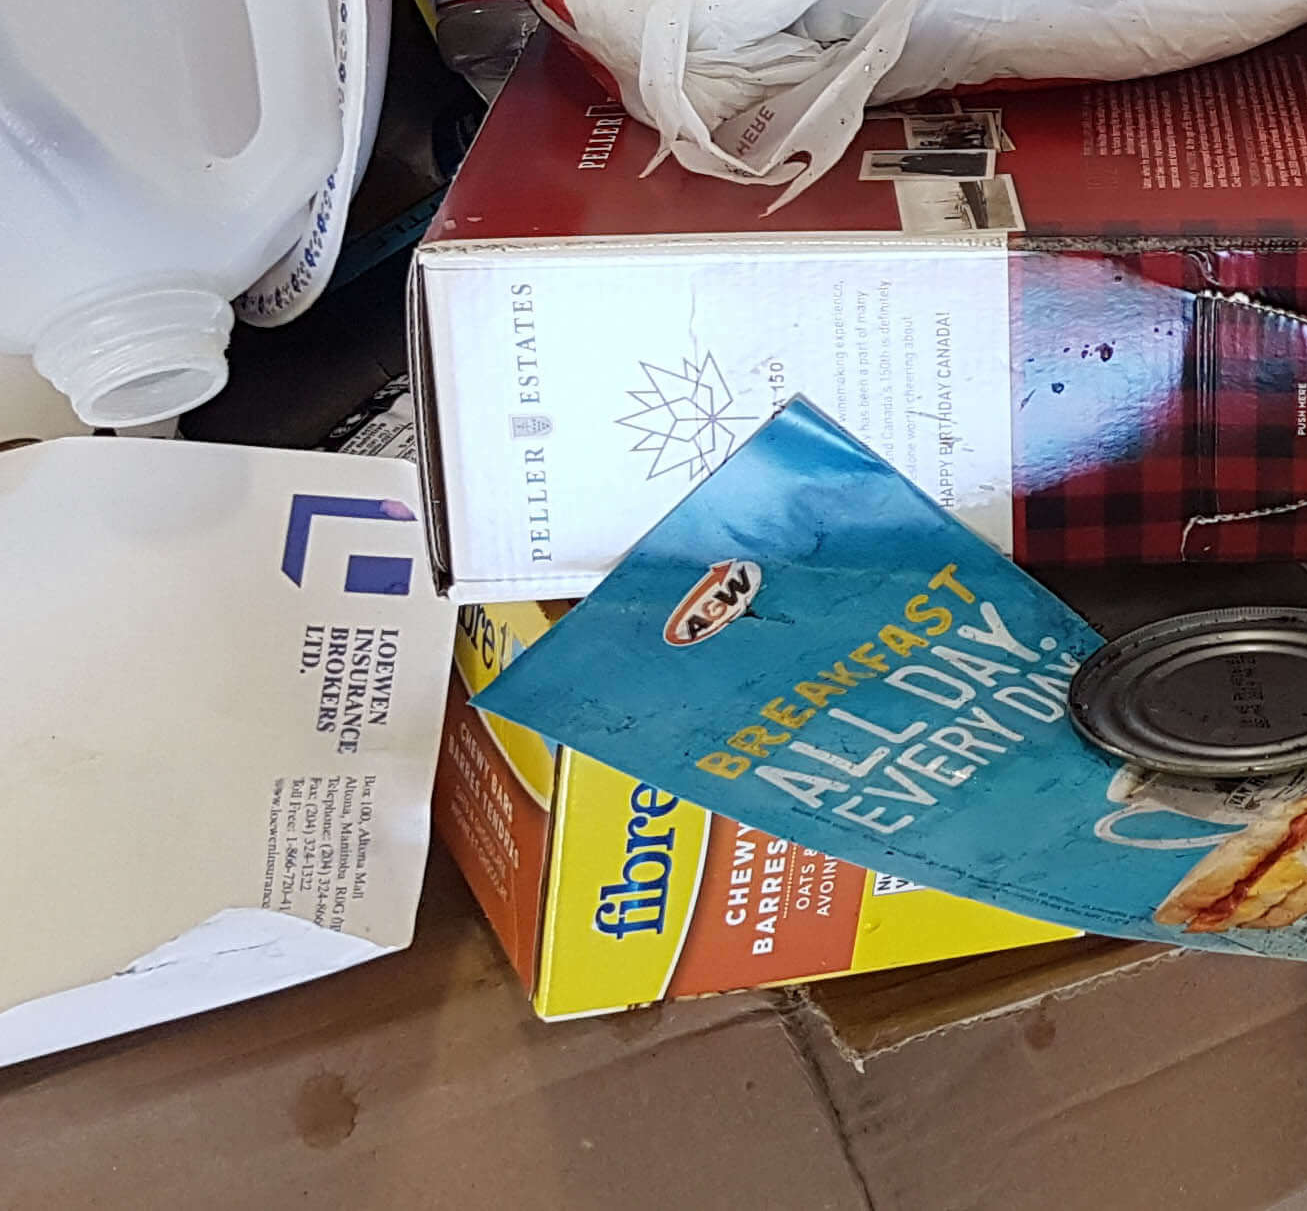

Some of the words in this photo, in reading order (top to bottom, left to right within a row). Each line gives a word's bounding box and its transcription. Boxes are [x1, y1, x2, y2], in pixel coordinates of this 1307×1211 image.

[577, 116, 625, 169] PELLER
[735, 104, 775, 157] HERE
[510, 283, 541, 405] ESTATES
[879, 279, 893, 341] definitely
[935, 311, 952, 379] CANADA!
[768, 361, 785, 393] 150
[937, 386, 954, 456] BIRTHDAY
[1296, 410, 1307, 436] PUSH
[523, 446, 553, 562] PELLER
[939, 461, 955, 508] HAPPY
[299, 625, 326, 675] LTD.
[316, 626, 350, 733] BROKERS
[368, 628, 399, 726] LOEWEN
[694, 564, 976, 781] BREAKFAST
[337, 627, 375, 755] INSURANCE
[753, 707, 929, 810] ALL
[884, 601, 1058, 710] DAY.
[831, 706, 1025, 835] EVERY
[304, 801, 319, 836] (204)
[319, 842, 332, 877] (204)
[594, 781, 680, 940] fibre
[724, 821, 757, 927] CHEWY
[795, 862, 816, 911] OATS
[751, 839, 790, 955] BARRES
